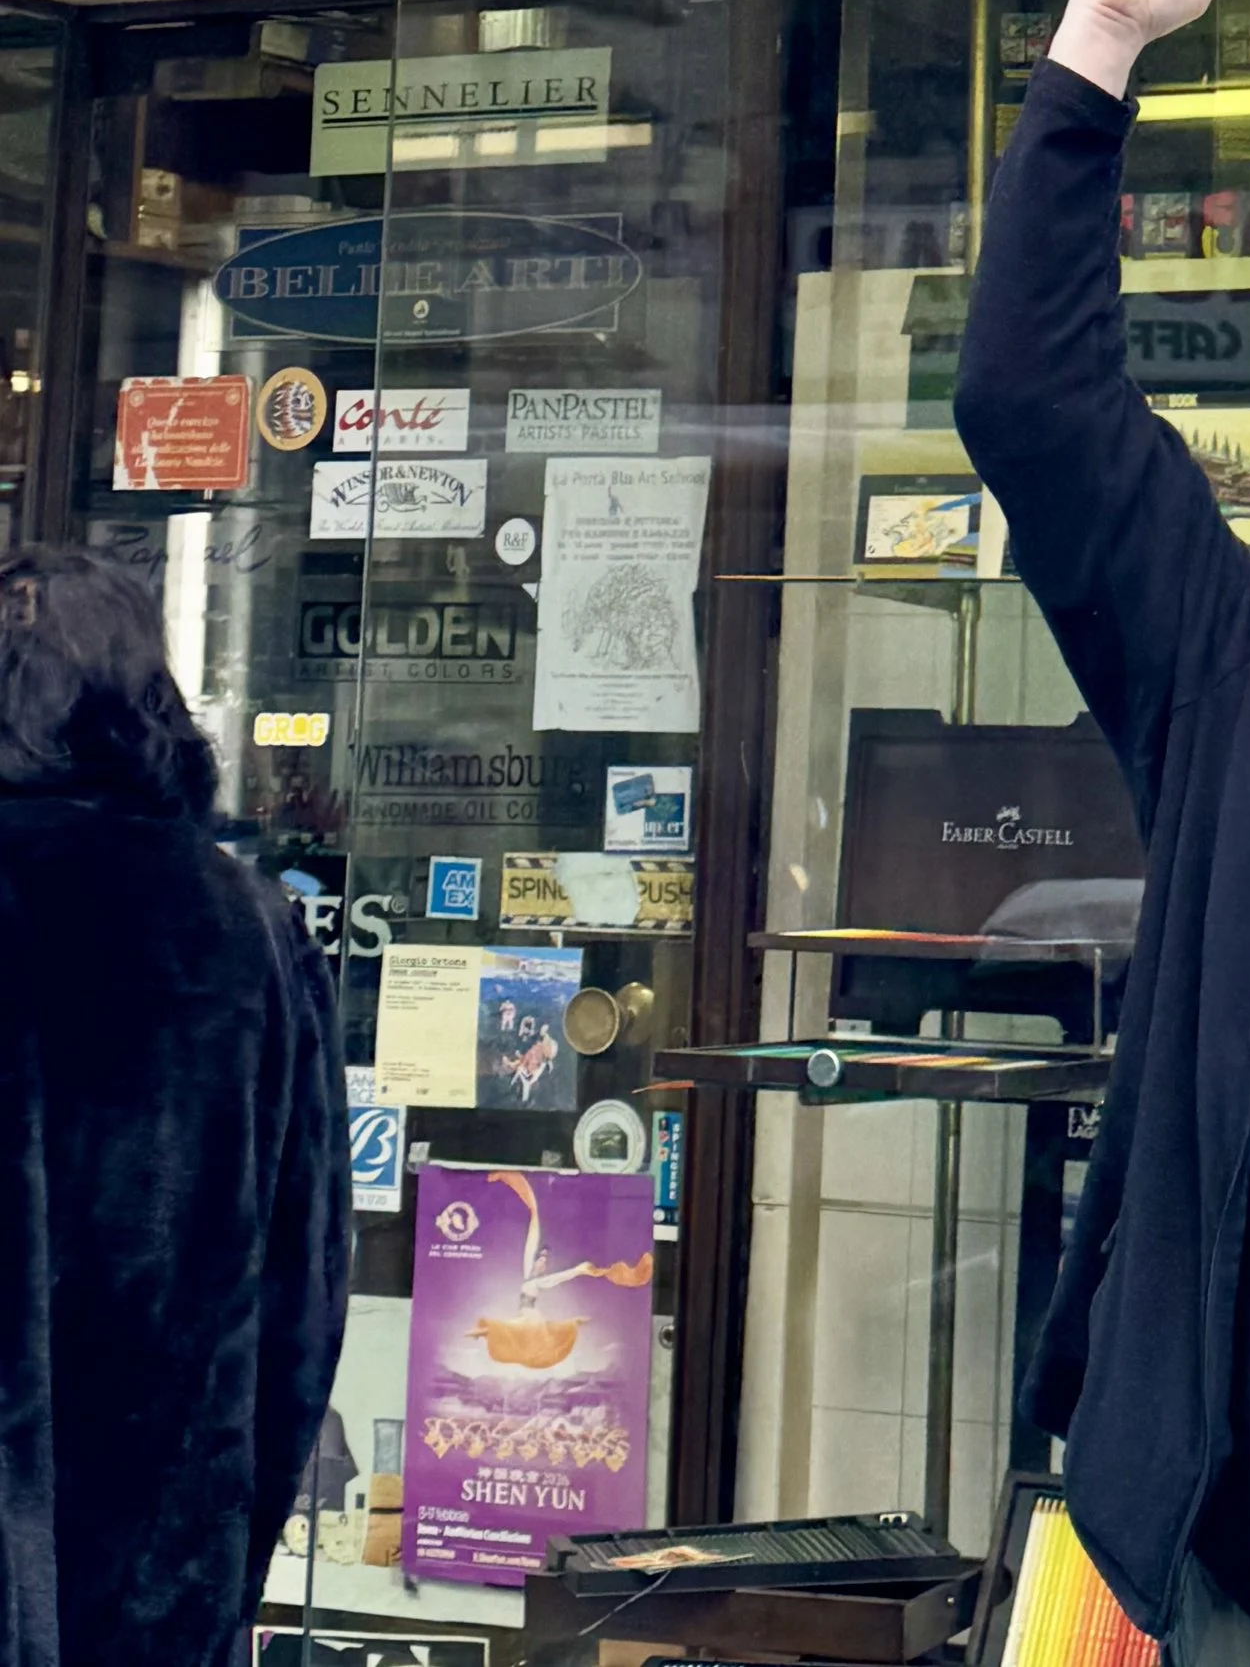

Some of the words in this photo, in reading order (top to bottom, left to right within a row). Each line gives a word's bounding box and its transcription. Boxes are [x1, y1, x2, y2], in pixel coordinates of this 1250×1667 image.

[321, 76, 599, 116] SENNELIER
[226, 263, 447, 300] BELLE
[454, 254, 632, 294] ARTI
[338, 396, 466, 431] Conté
[581, 424, 641, 440] PASTELS
[106, 524, 272, 579] Rapael
[503, 532, 529, 548] R&F
[302, 604, 512, 659] GOLDEN
[301, 662, 389, 679] ARTIST
[407, 663, 514, 680] COLORS
[669, 1122, 681, 1201] SPINGERE
[460, 1478, 528, 1506] SHEN
[534, 1485, 586, 1512] YUN
